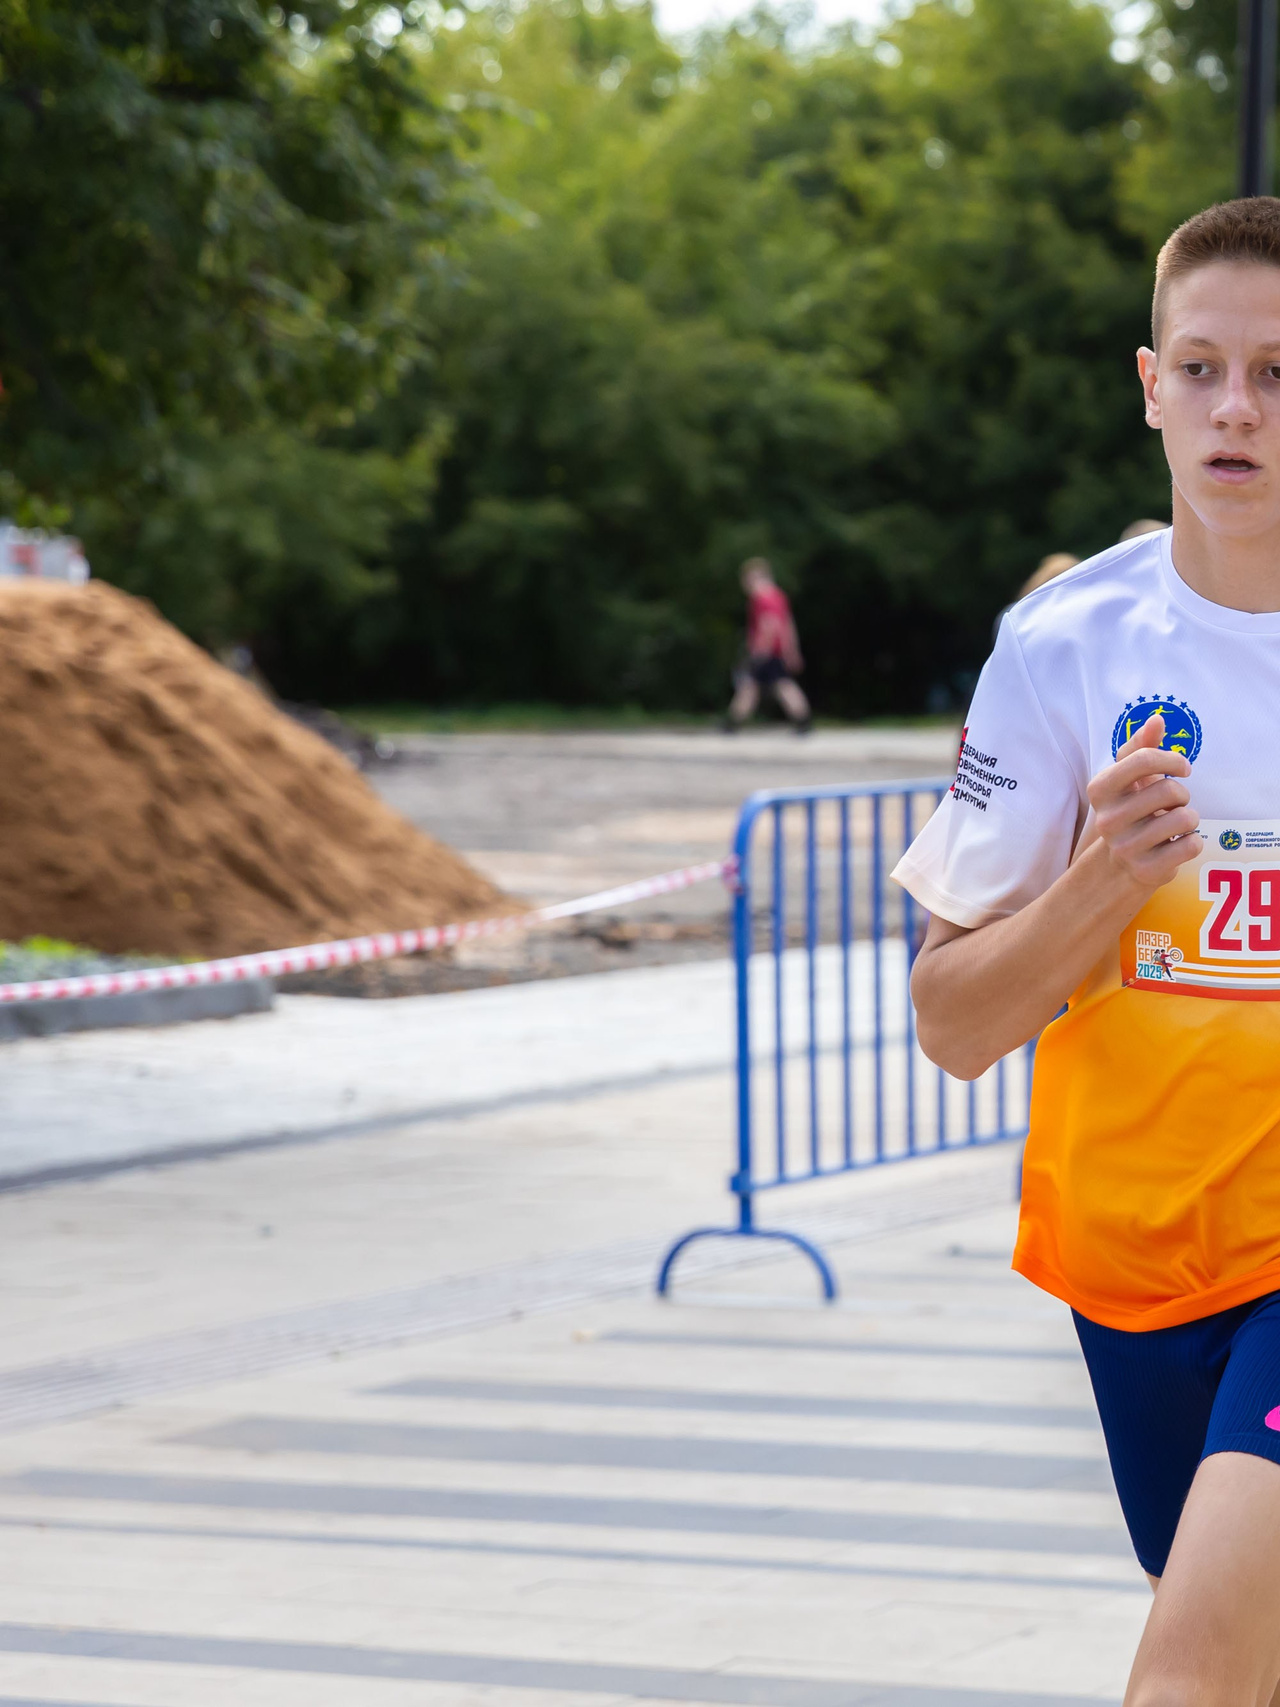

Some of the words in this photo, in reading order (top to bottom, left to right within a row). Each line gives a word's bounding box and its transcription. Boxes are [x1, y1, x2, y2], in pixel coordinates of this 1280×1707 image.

[962, 742, 998, 768] ДЕРАЦИЯ
[956, 773, 992, 799] ЯТИБОРЬЯ
[958, 758, 1018, 790] ОВРЕМЕННОГО
[953, 788, 988, 812] ДМУРТИИ
[1138, 931, 1169, 947] ЛАЗЕР
[1137, 963, 1162, 979] 2025
